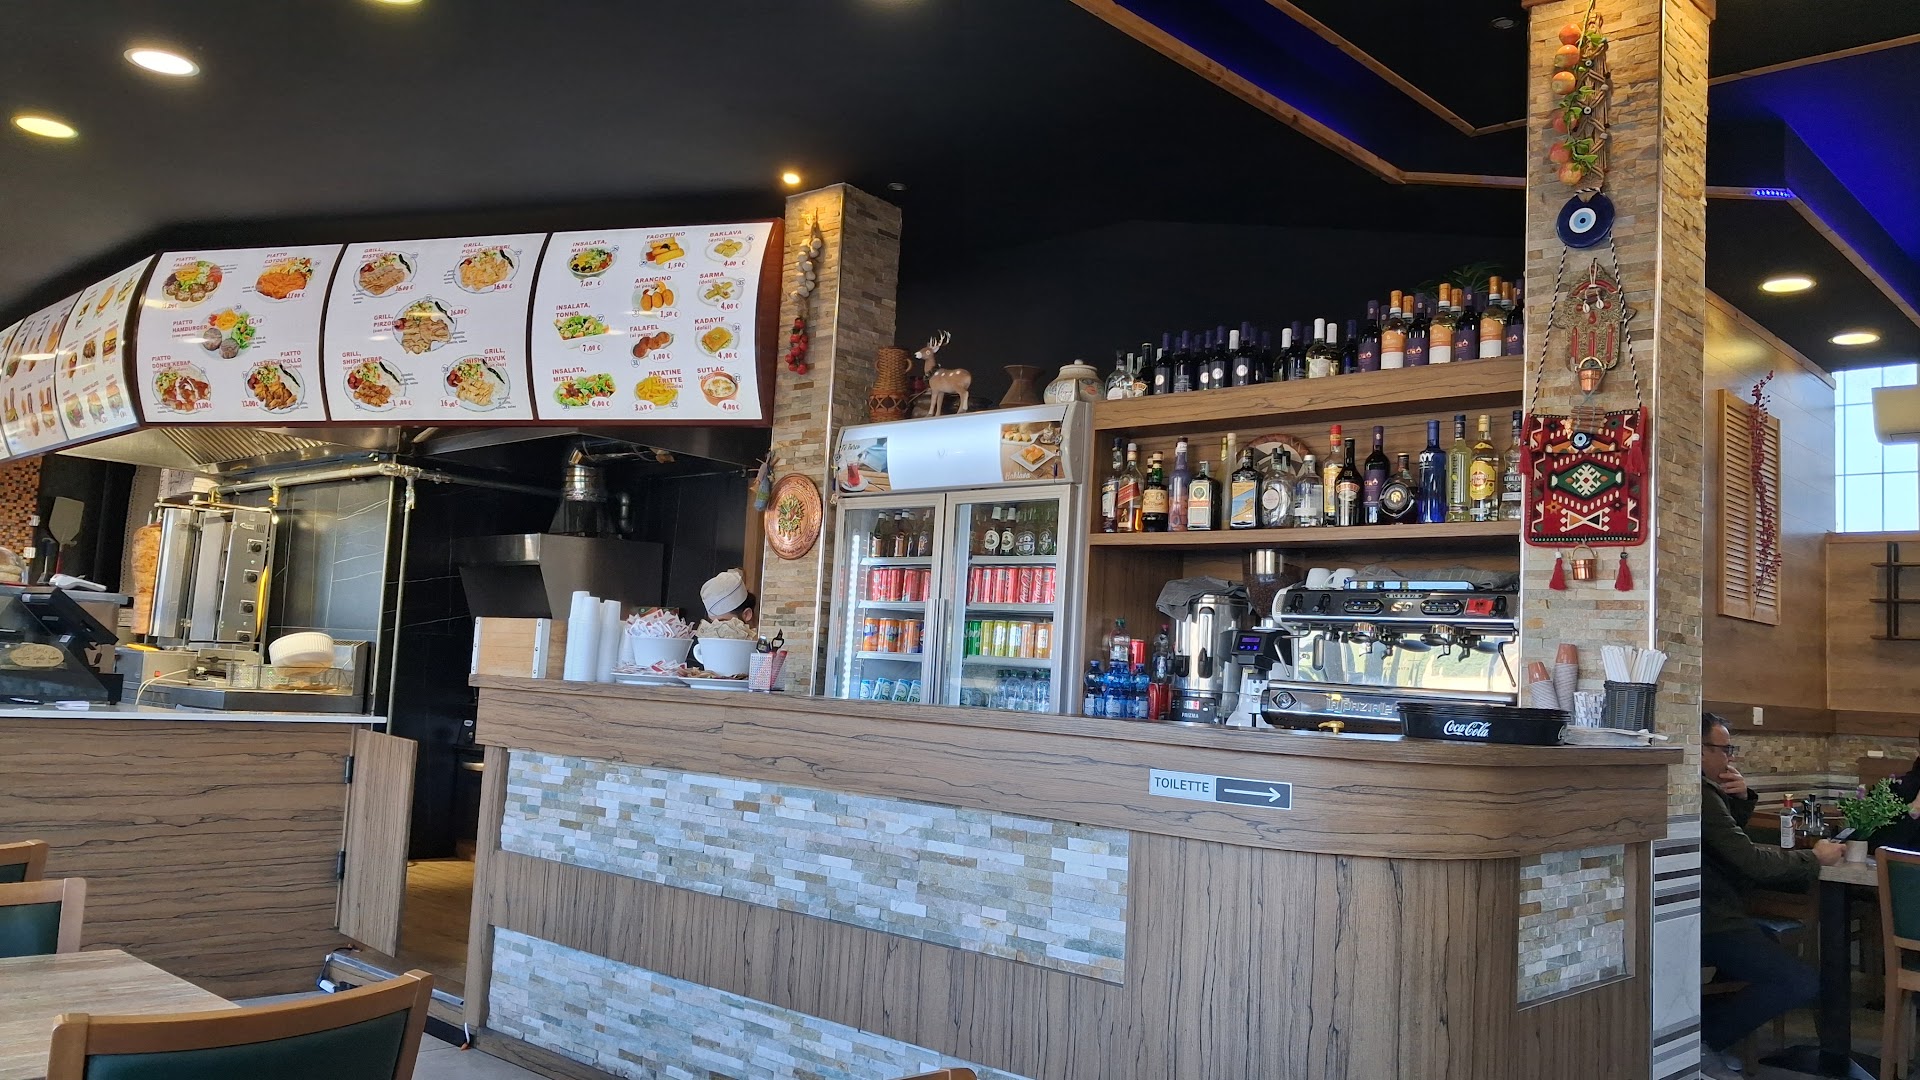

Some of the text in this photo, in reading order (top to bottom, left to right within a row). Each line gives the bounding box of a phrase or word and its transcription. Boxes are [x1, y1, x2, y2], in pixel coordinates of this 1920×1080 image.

[694, 316, 725, 324] KADAYIF
[172, 325, 208, 333] HAMBURGER
[552, 366, 587, 375] INSALATA,
[648, 368, 682, 376] PATATINE
[553, 375, 574, 383] MISTA
[1443, 719, 1492, 738] Coca-Cola
[1154, 776, 1210, 793] TOILETTE
